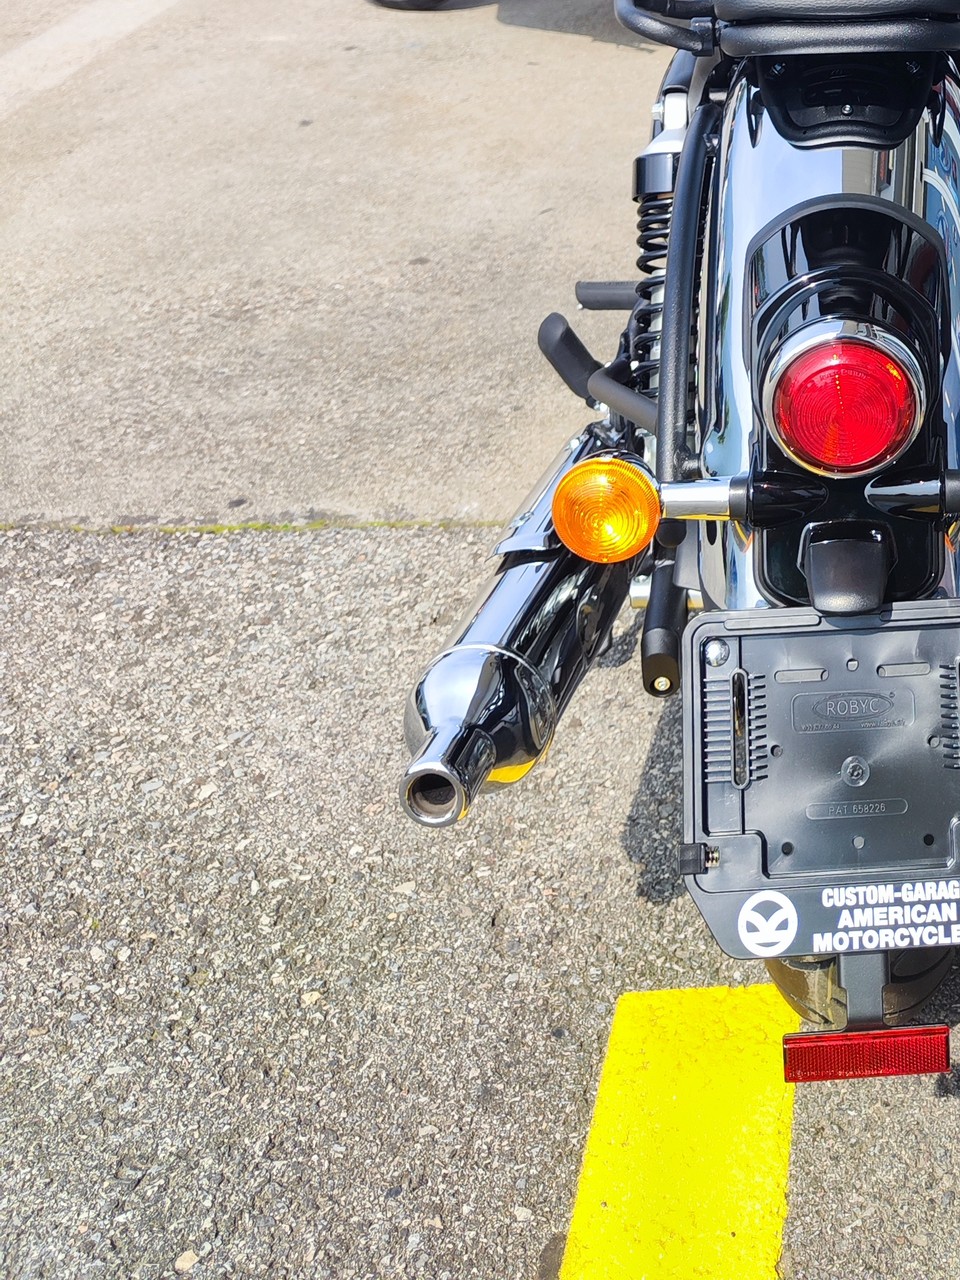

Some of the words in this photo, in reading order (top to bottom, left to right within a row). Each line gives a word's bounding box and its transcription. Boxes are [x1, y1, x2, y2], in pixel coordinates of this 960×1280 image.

[826, 698, 880, 716] ROBYC
[828, 805, 847, 816] PAT
[852, 802, 886, 814] 658226
[837, 902, 958, 929] AMERICAN
